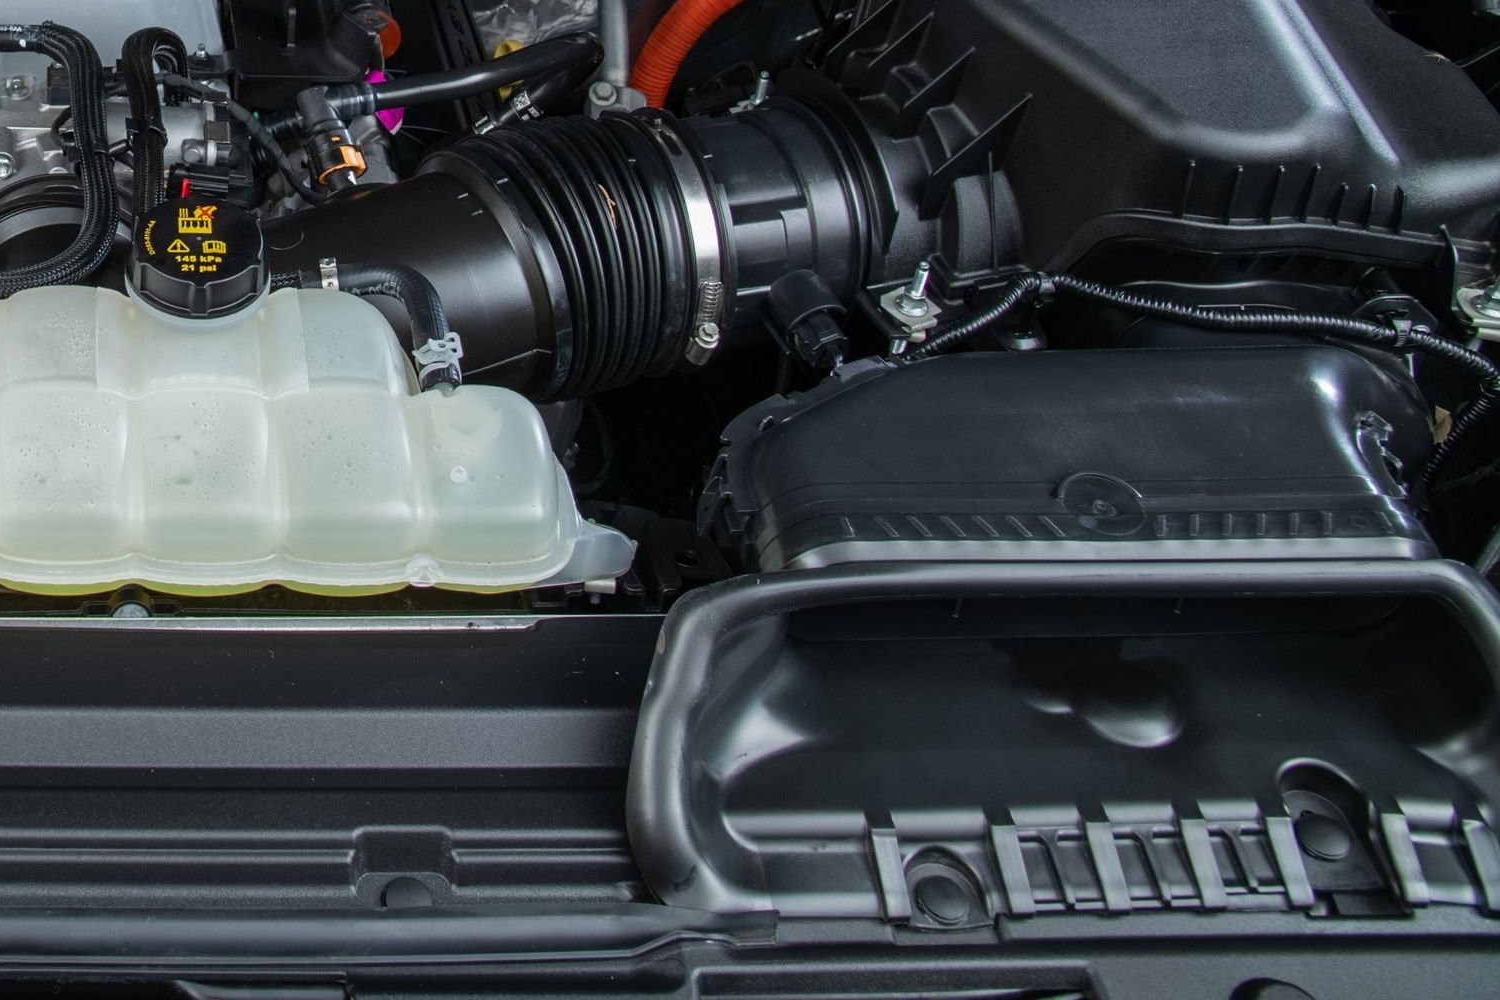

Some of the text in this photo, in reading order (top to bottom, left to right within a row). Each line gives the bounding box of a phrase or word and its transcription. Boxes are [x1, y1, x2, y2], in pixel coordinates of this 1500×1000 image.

[175, 255, 222, 263] 145 kPa
[181, 264, 217, 273] 21 psi
